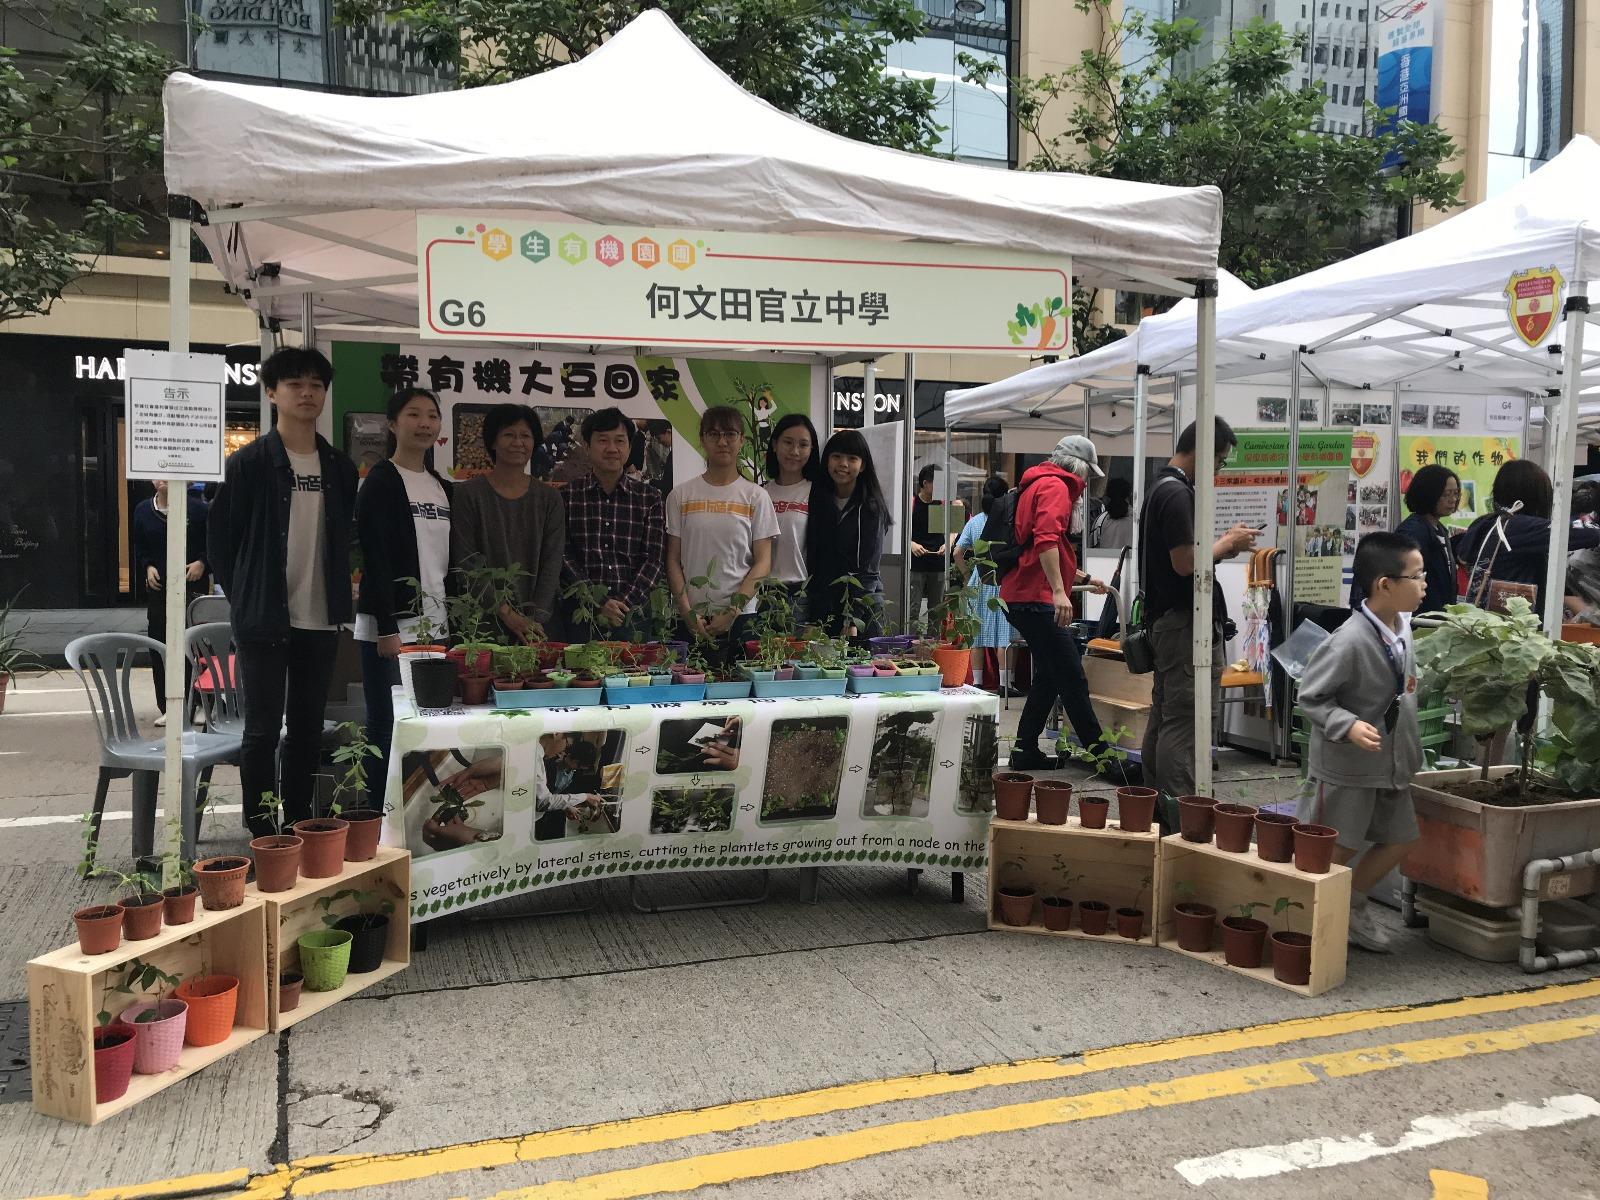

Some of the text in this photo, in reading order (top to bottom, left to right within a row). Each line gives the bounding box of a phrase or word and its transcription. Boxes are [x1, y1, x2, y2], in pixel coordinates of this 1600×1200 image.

[487, 234, 689, 264] 學生有機園圃
[439, 299, 486, 328] G6
[645, 282, 889, 326] 何文田官立中學
[380, 353, 680, 401] 帶有機大豆回家
[163, 387, 190, 399] 告示
[1501, 401, 1512, 410] G4
[1317, 441, 1345, 453] Garden
[1416, 449, 1504, 466] 我們的作物
[423, 866, 511, 898] vegetatively
[515, 862, 533, 876] by
[537, 851, 584, 870] lateral
[588, 849, 634, 862] stems,
[639, 845, 688, 857] cutting
[692, 842, 716, 854] the
[720, 841, 779, 857] plantlets
[782, 837, 832, 852] growing
[836, 835, 857, 846] out
[862, 834, 893, 846] from
[897, 838, 905, 847] a
[909, 836, 940, 850] node
[944, 841, 960, 851] on
[965, 840, 985, 851] the
[34, 1008, 42, 1069] POMEROL
